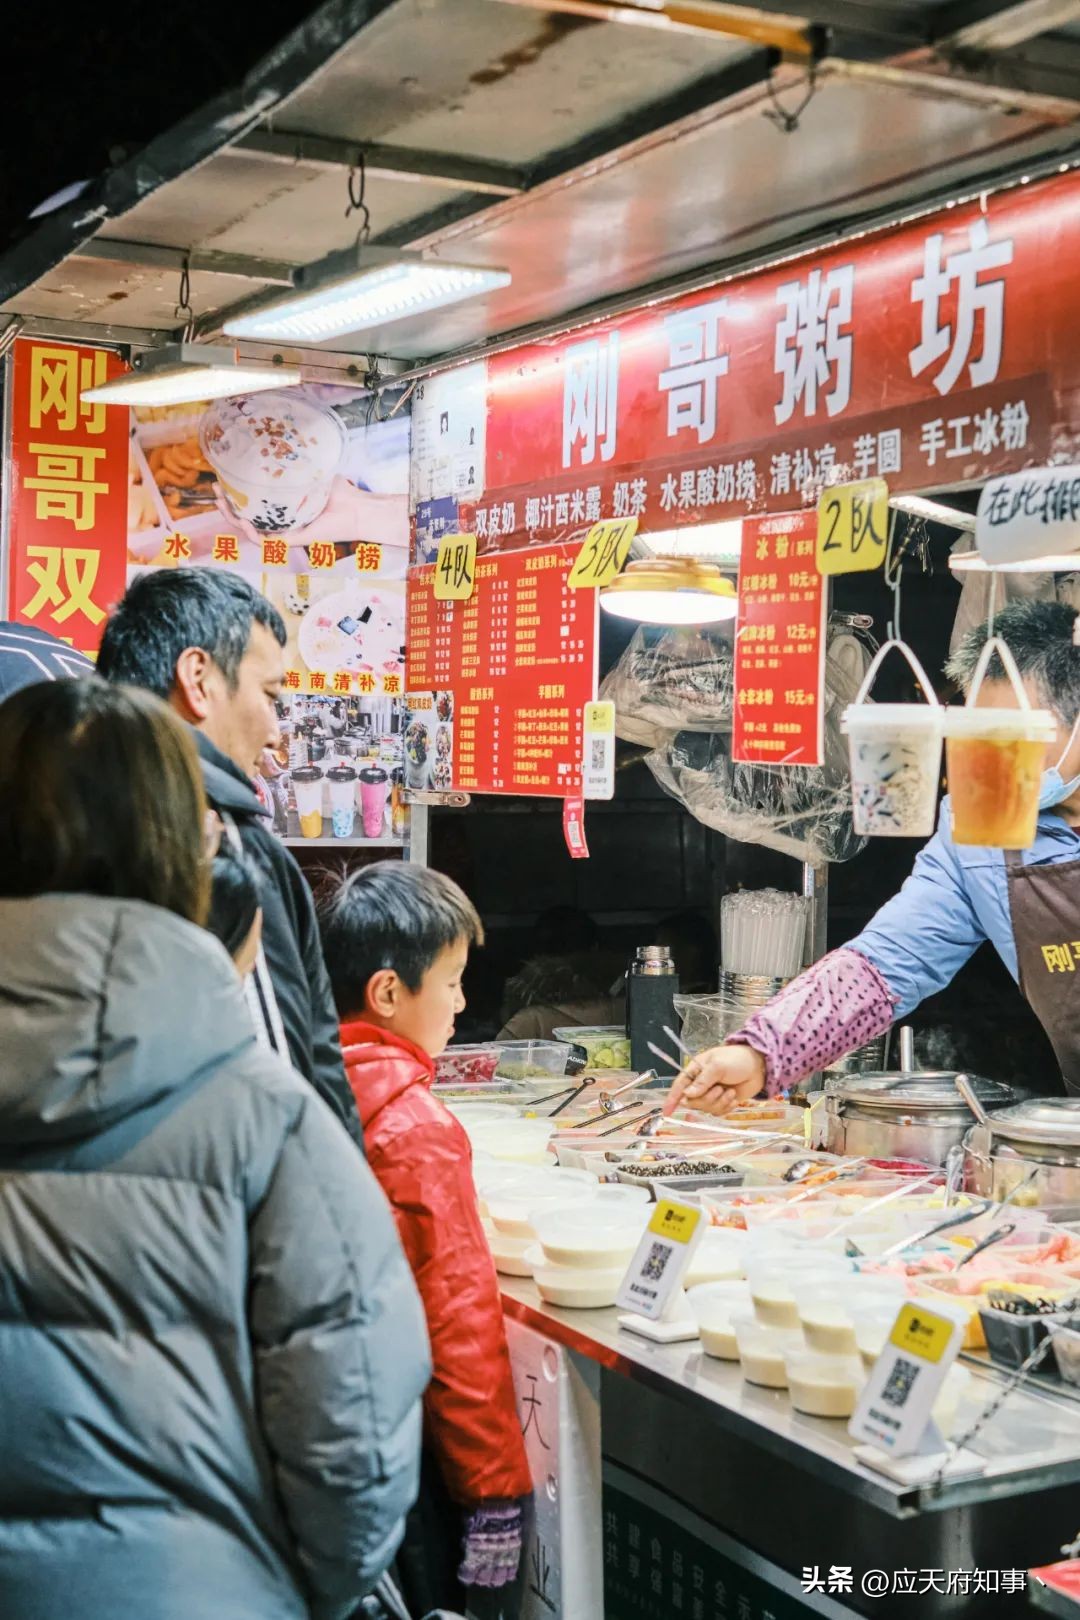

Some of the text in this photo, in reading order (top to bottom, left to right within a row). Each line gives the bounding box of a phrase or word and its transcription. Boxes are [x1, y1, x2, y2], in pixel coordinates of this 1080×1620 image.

[561, 218, 1014, 469] 刚哥粥坊
[475, 501, 516, 538] 双皮奶
[525, 485, 601, 530] 椰汁西米露
[612, 477, 648, 517] 奶茶
[659, 458, 757, 512] 水果酸奶捞
[853, 428, 902, 480] 芋圆
[918, 400, 1030, 467] 手工冰粉
[20, 346, 109, 664] 刚哥双
[823, 494, 884, 554] 2队
[165, 533, 383, 571] 水果酸奶捞
[440, 544, 472, 589] 4队
[577, 524, 627, 578] 3队
[285, 670, 401, 692] 海南清补凉
